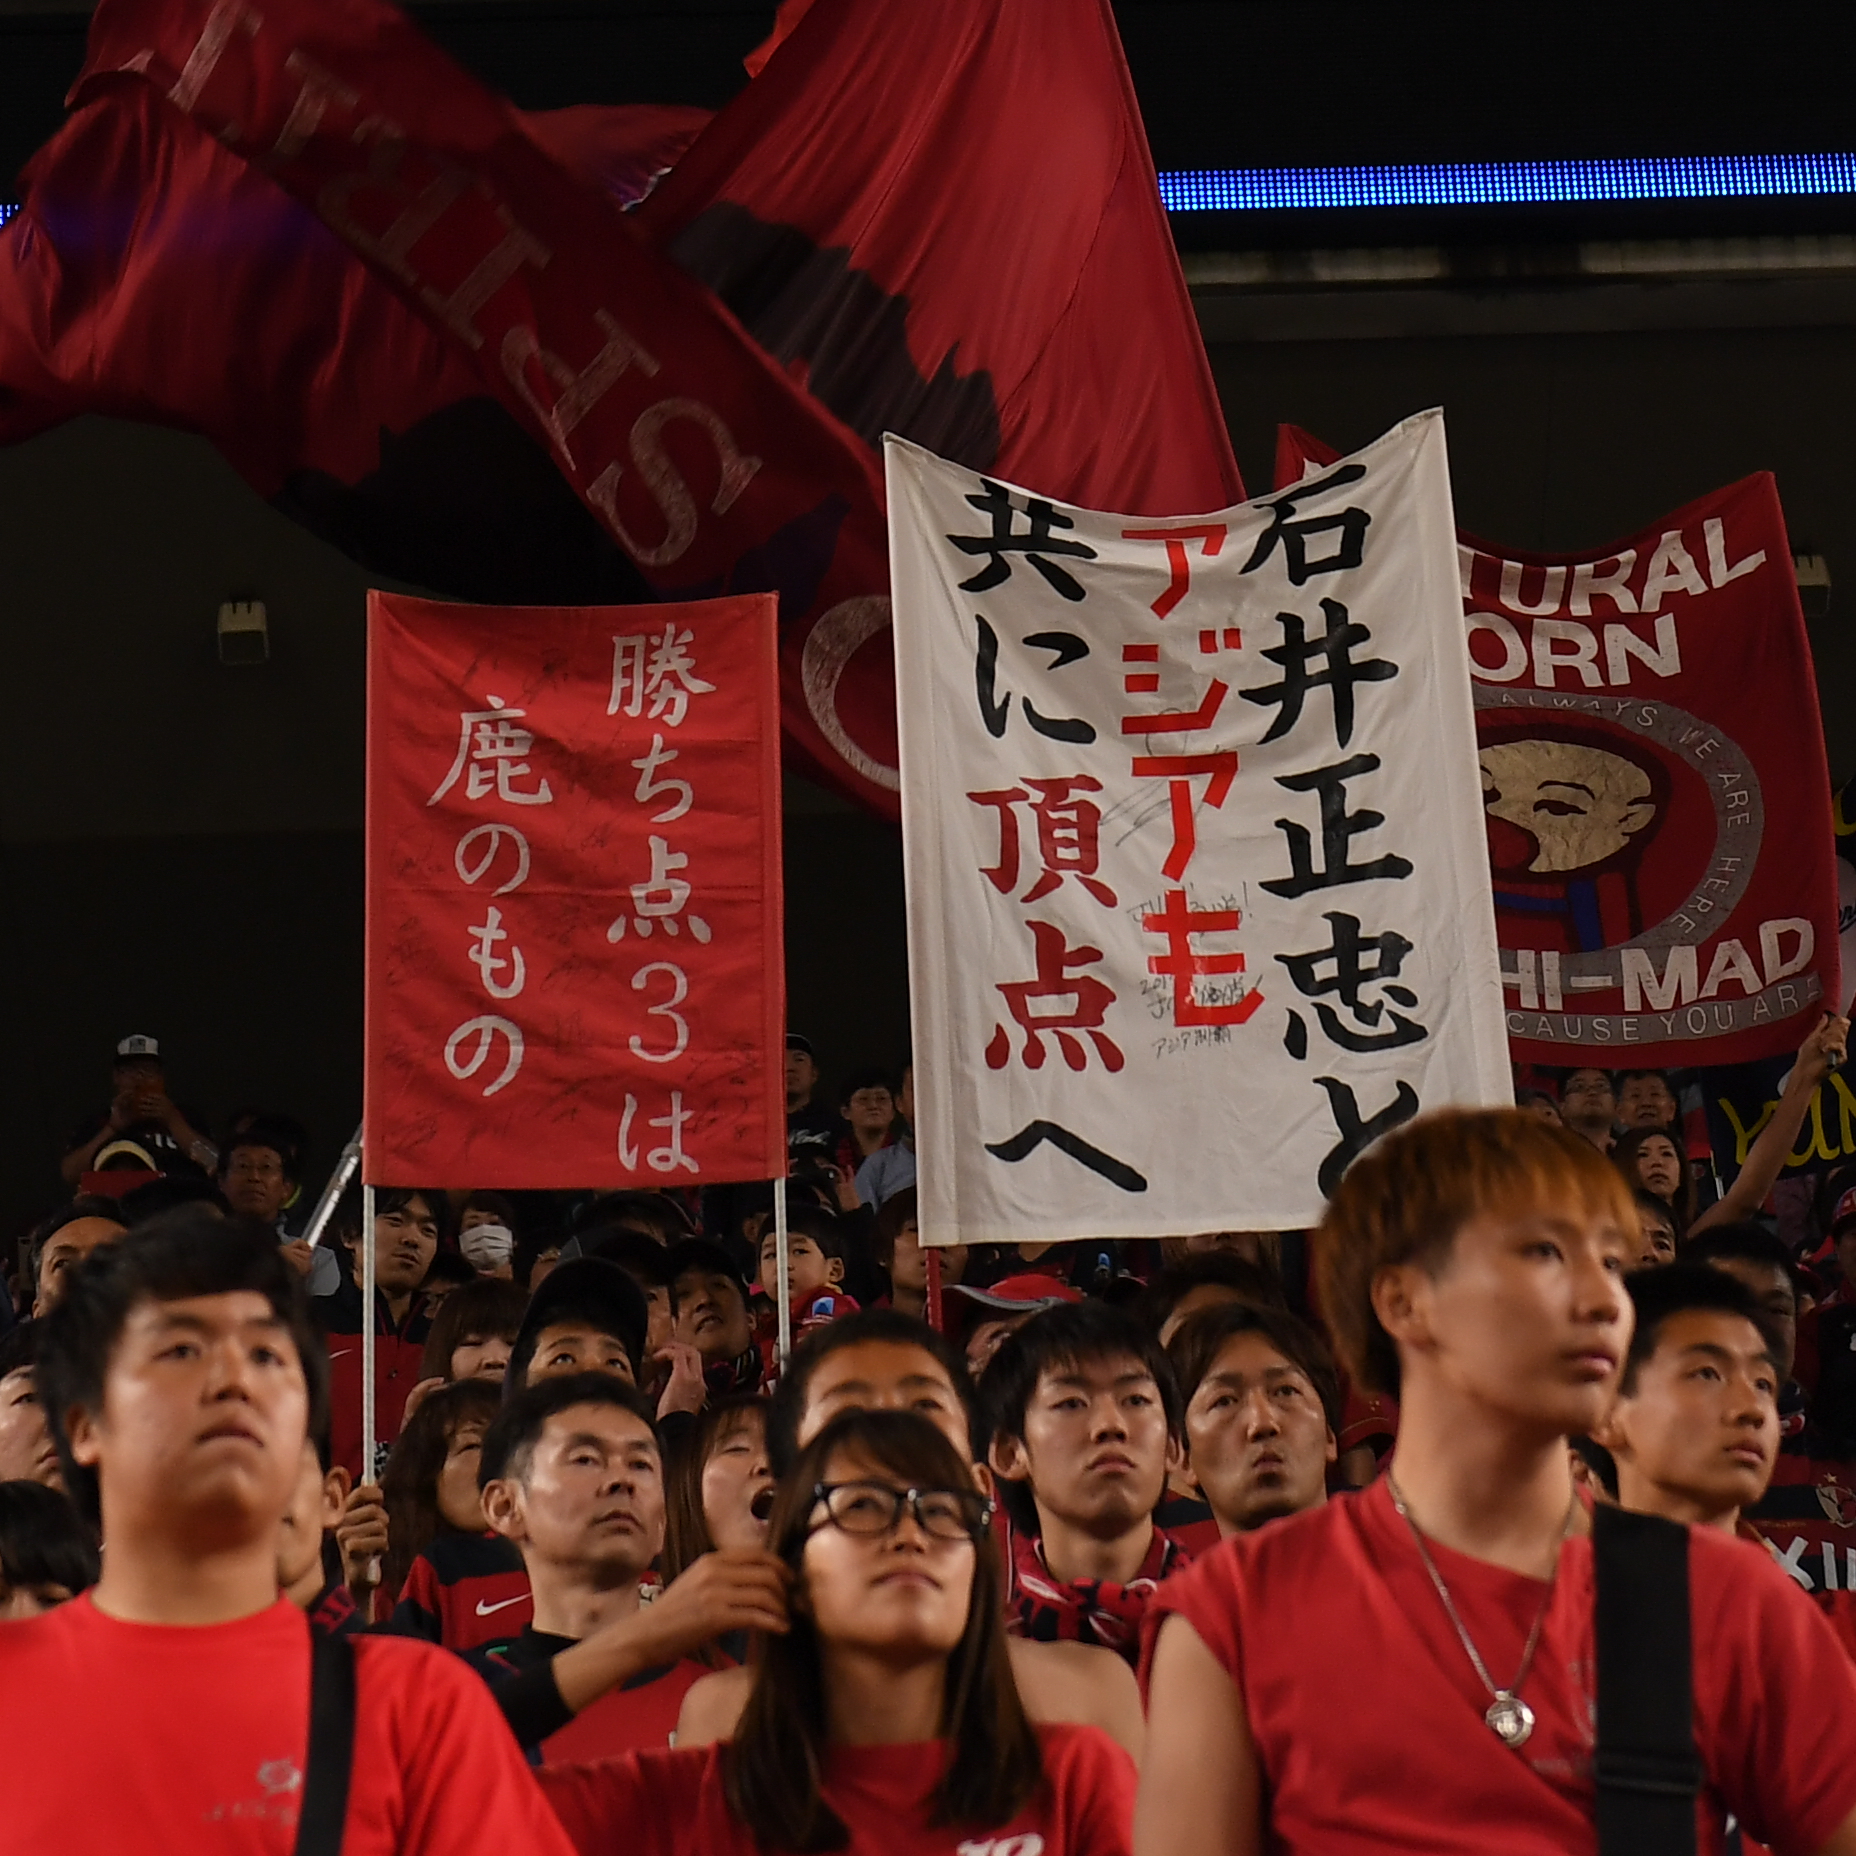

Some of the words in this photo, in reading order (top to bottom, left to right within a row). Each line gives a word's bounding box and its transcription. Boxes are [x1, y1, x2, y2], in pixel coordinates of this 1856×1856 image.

[947, 477, 1148, 1192] 共に頂点へ
[1239, 464, 1428, 1201] 石井正忠と
[1679, 726, 1721, 761] WE
[1717, 772, 1751, 829] ARE
[426, 694, 553, 1097] 鹿のもの
[607, 623, 717, 1175] 勝ち点3は
[1670, 855, 1743, 935] HERE
[1659, 1004, 1735, 1036] YOU
